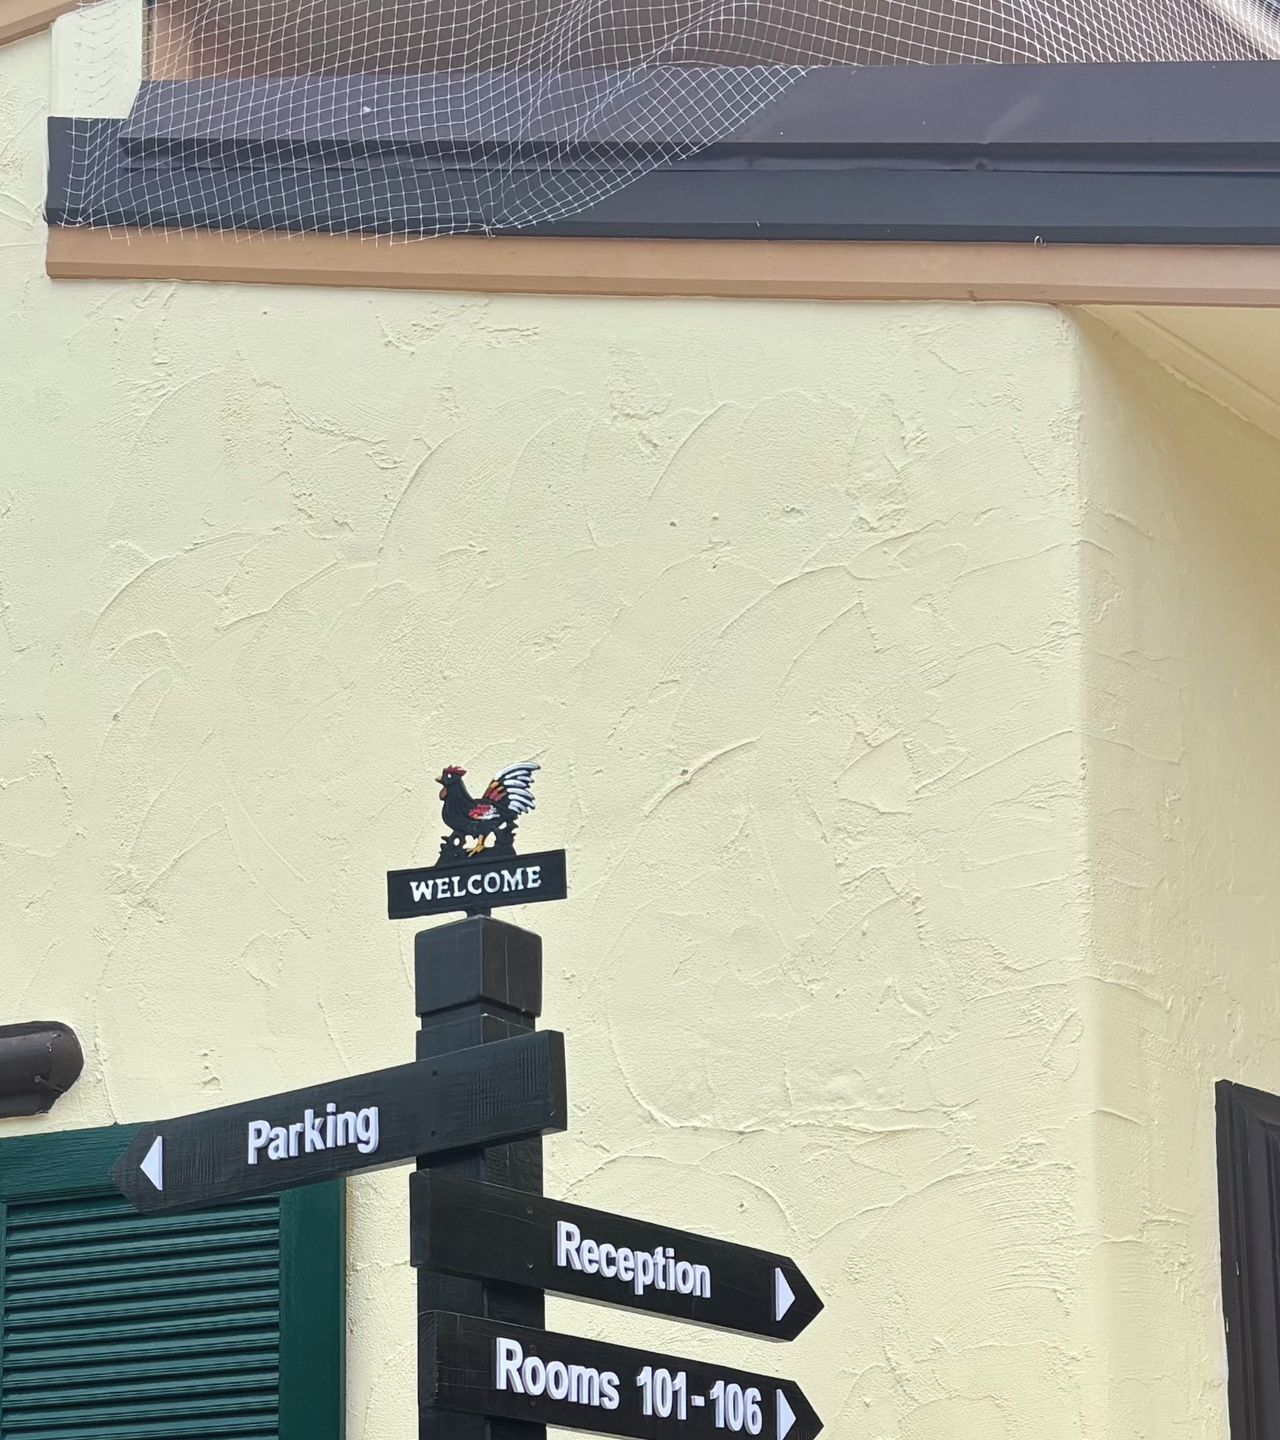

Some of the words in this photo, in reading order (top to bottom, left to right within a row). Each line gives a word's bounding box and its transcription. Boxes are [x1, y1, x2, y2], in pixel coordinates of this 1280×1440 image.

[410, 865, 542, 903] WELCOME
[248, 1103, 379, 1164] Parking
[556, 1220, 712, 1298] Reception
[496, 1337, 620, 1409] Rooms
[636, 1366, 763, 1435] 101-106
